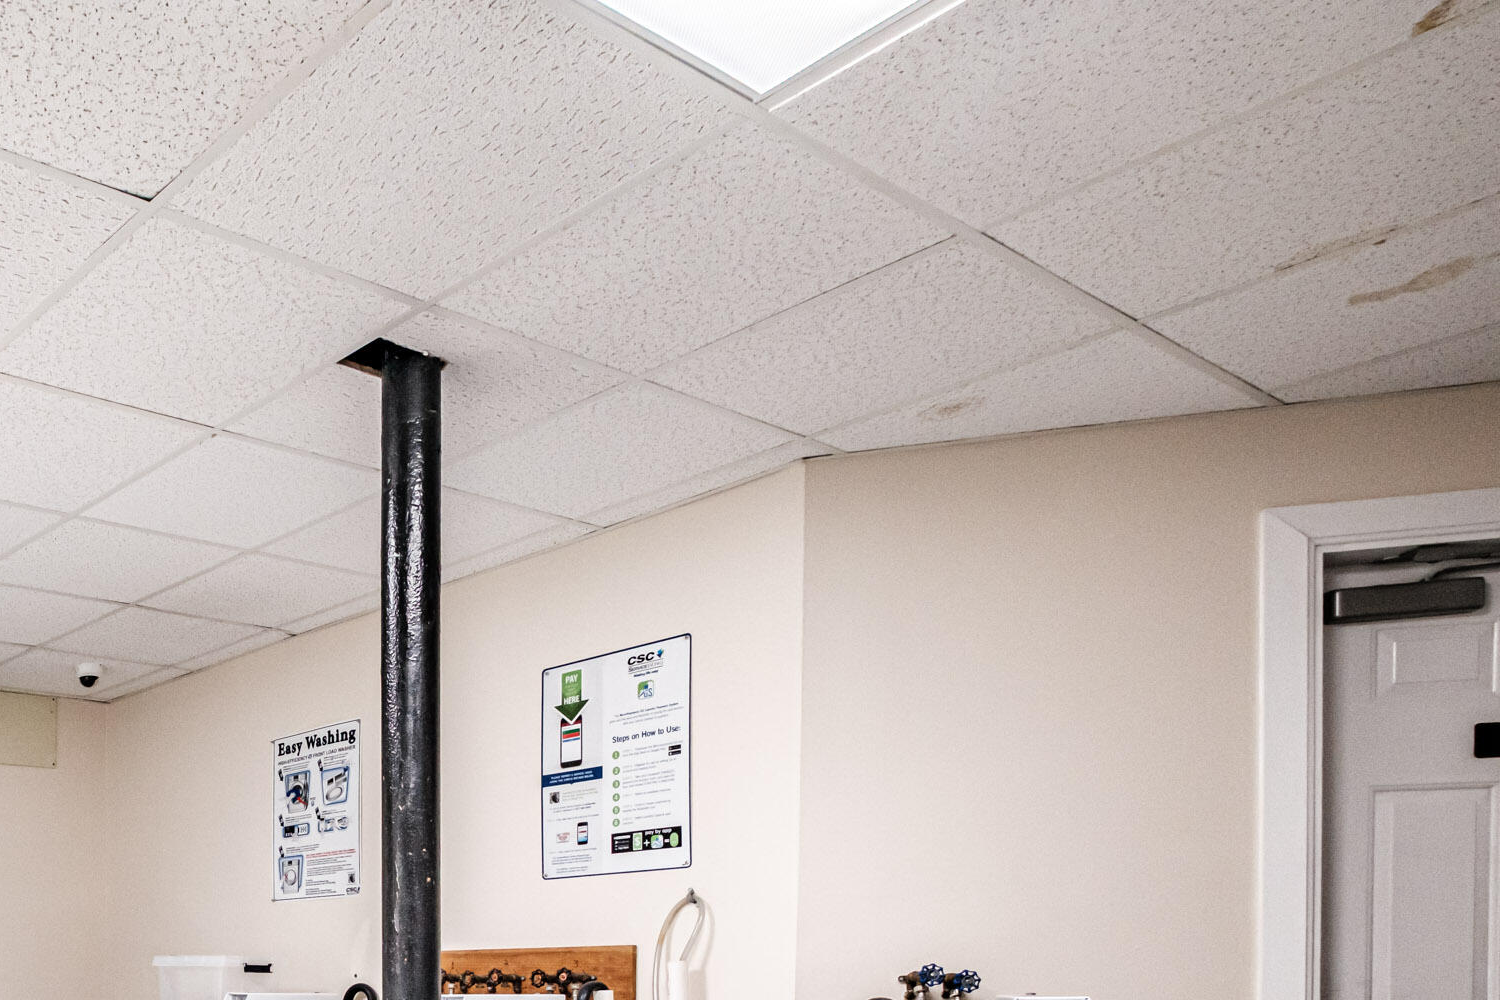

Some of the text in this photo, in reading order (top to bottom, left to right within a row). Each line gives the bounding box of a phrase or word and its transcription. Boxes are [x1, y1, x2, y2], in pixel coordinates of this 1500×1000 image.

[628, 652, 655, 666] CSC
[565, 674, 578, 684] PAY
[564, 695, 580, 705] HERE
[278, 729, 356, 756] Easy Washing
[612, 735, 630, 744] Steps
[642, 730, 656, 738] How
